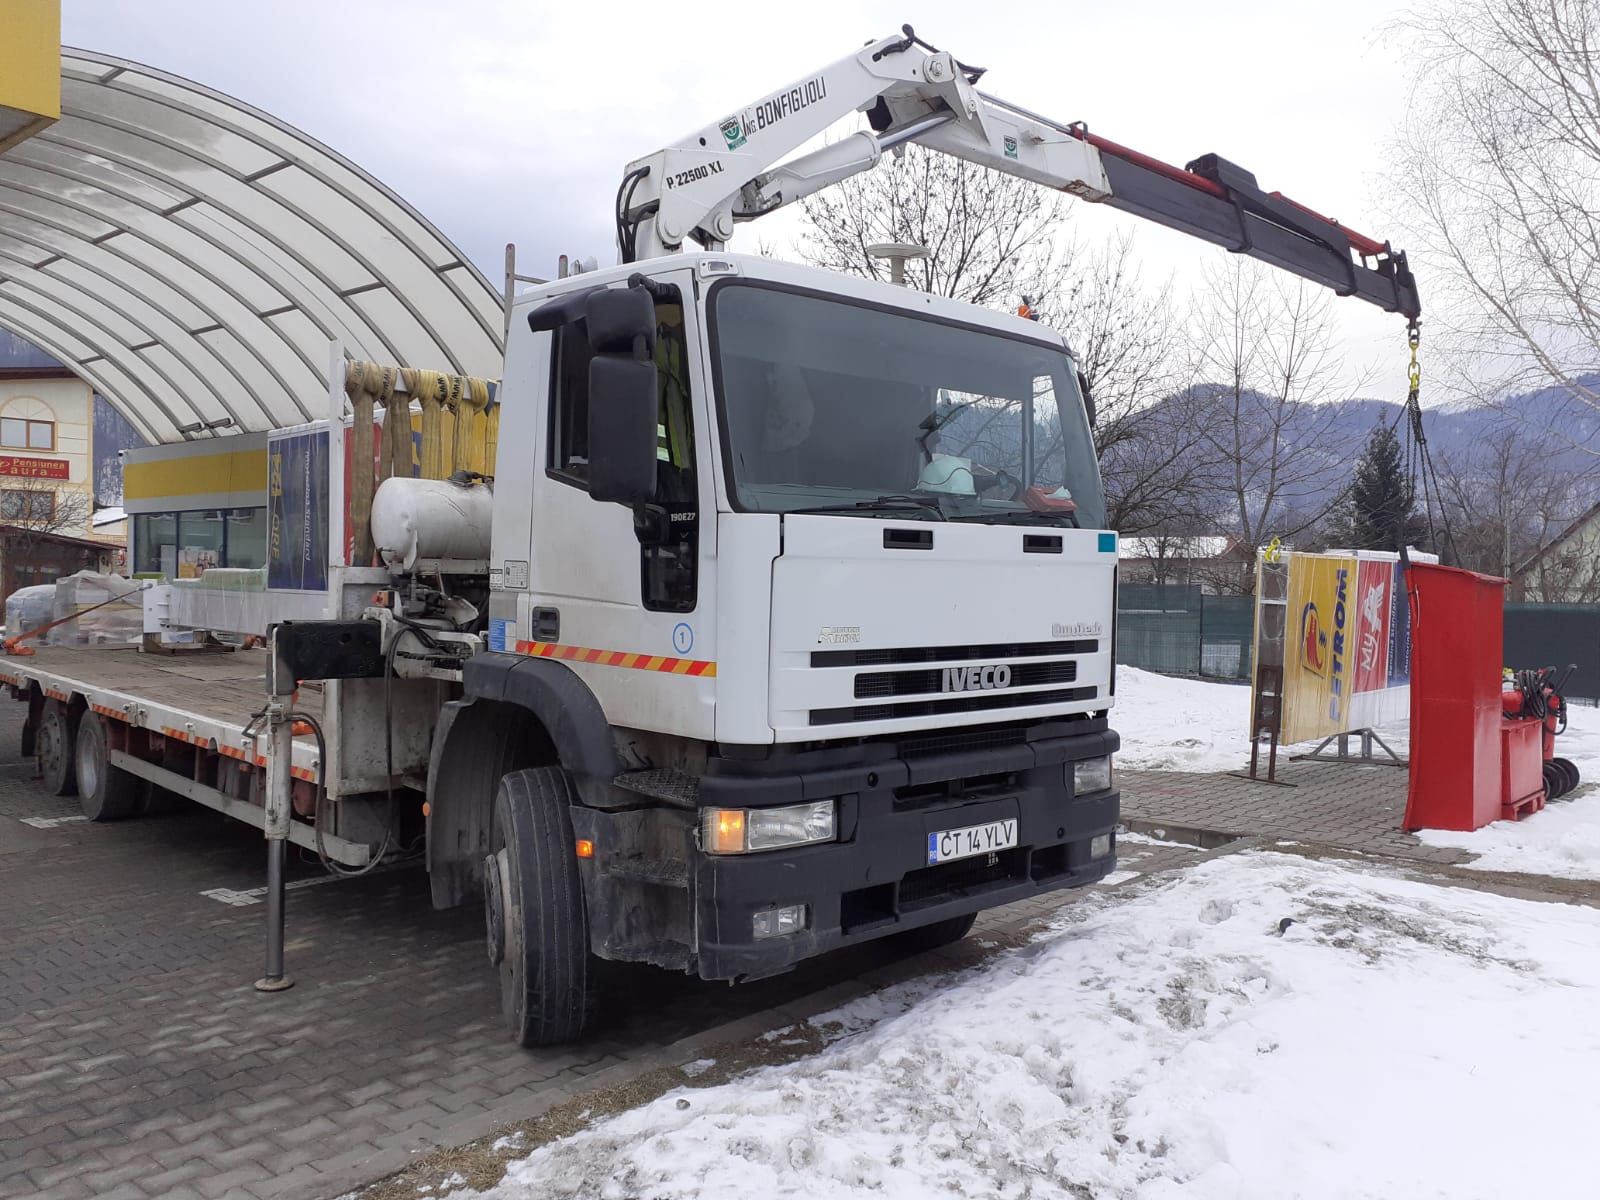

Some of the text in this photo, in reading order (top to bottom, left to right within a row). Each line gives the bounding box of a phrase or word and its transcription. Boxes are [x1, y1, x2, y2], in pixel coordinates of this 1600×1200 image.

[756, 76, 827, 130] BONFIGLIOLI
[676, 165, 709, 187] 22500
[708, 160, 724, 175] XL
[13, 458, 65, 470] Pensiunea
[670, 512, 696, 522] 190E27
[679, 632, 685, 644] 1
[1330, 568, 1347, 722] PETROM
[1361, 633, 1379, 671] My
[942, 665, 1011, 692] IVECO
[941, 833, 961, 856] CT
[967, 830, 980, 852] 14
[985, 822, 1013, 848] YLV
